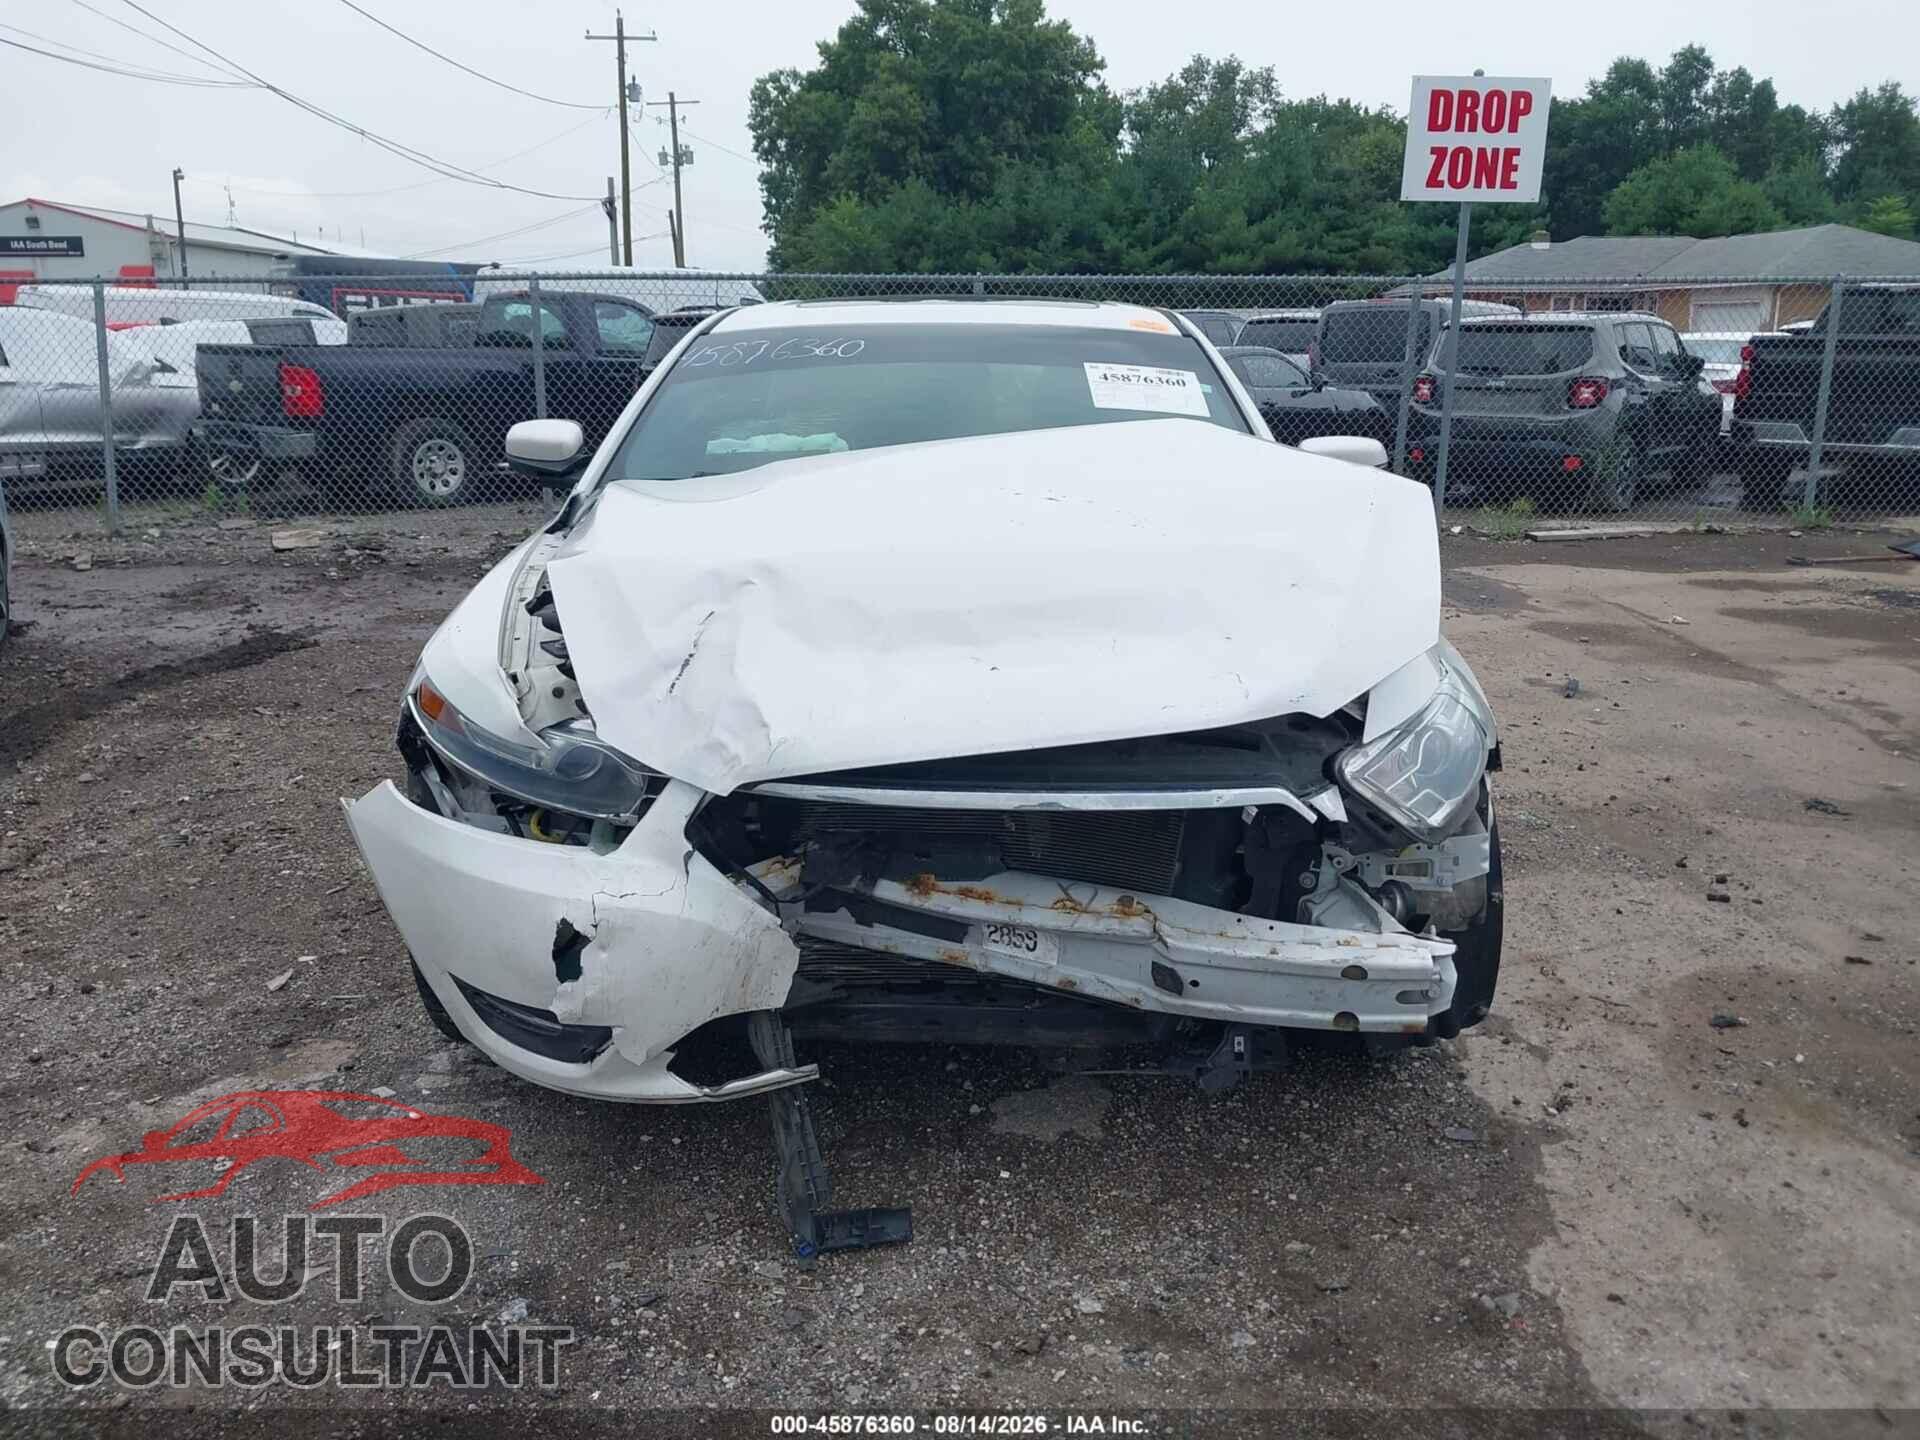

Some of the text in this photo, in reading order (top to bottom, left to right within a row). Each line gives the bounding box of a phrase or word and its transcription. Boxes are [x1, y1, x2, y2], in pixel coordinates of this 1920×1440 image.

[1427, 88, 1533, 134] DROP
[1425, 146, 1521, 190] ZONE
[10, 240, 25, 249] IAA
[681, 337, 865, 368] 45876360
[1099, 372, 1187, 388] 45876360
